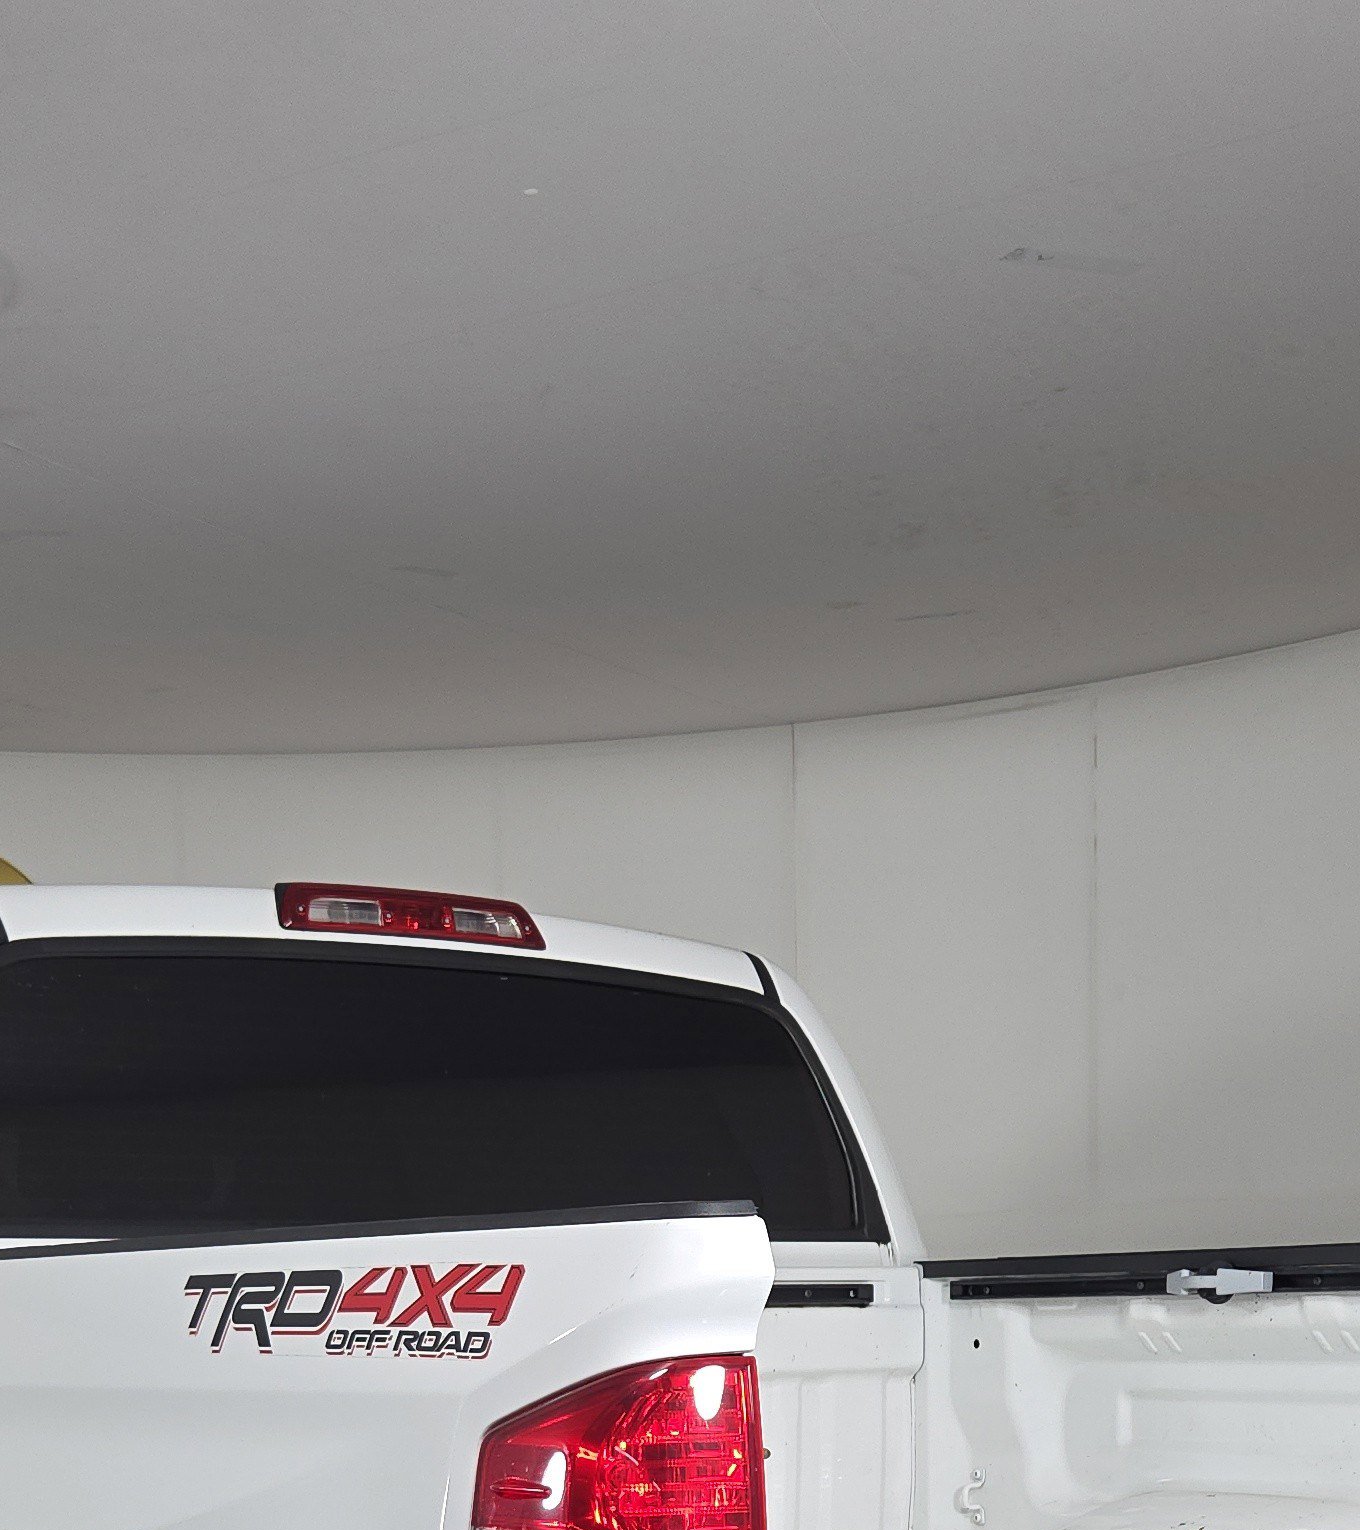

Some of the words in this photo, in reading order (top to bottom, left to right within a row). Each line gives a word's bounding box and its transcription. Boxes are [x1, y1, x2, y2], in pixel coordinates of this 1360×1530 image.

[184, 1269, 343, 1354] TRD
[324, 1329, 393, 1356] OFF
[393, 1329, 493, 1359] ROAD
